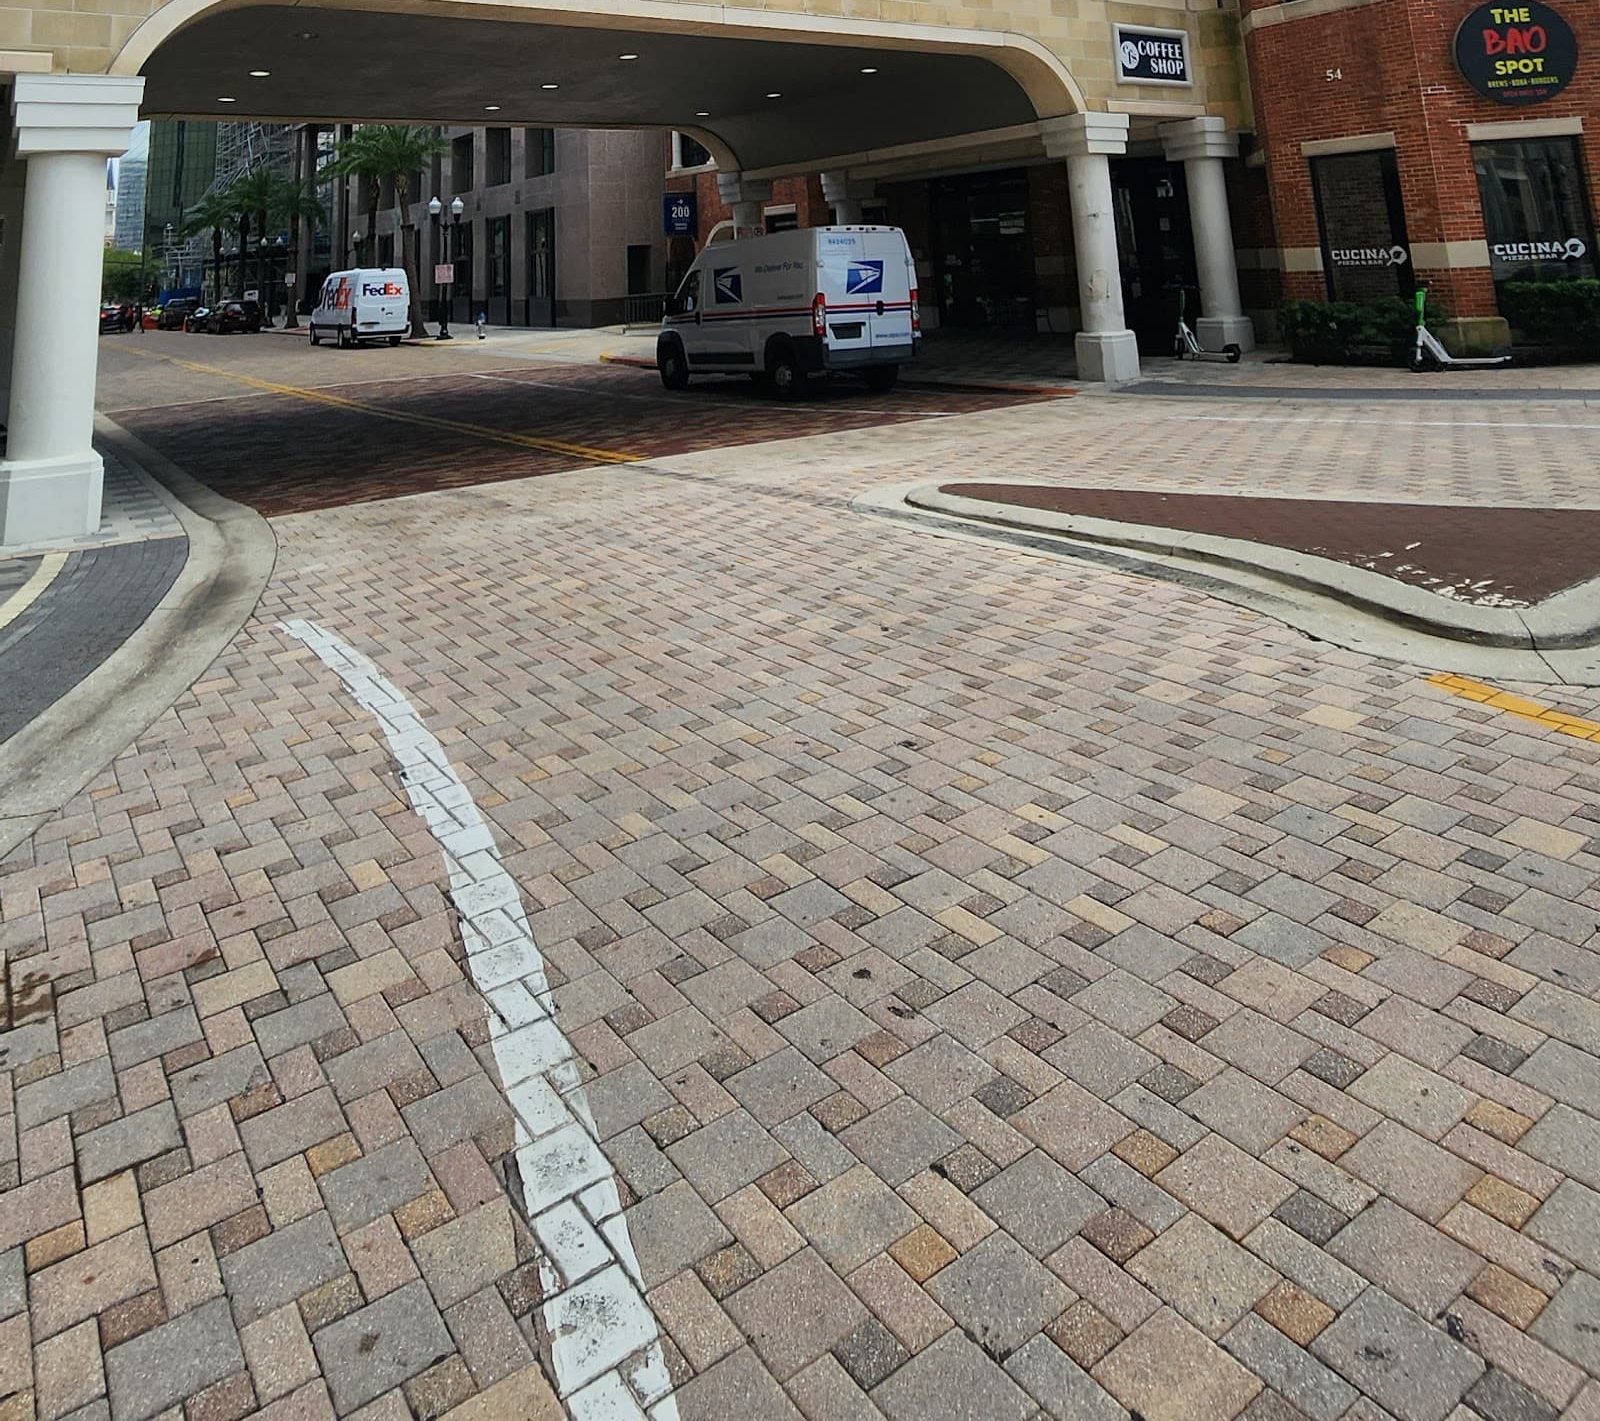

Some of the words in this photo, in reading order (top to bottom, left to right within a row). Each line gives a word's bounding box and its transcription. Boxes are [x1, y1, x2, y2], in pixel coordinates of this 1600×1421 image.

[1490, 7, 1531, 24] THE
[1482, 25, 1547, 55] BAO
[1137, 40, 1182, 59] COFFEE
[1150, 58, 1183, 75] SHOP
[1494, 58, 1544, 75] SPOT
[1326, 69, 1343, 81] 54
[671, 206, 690, 218] 200
[1331, 248, 1390, 260] CUCINA
[1494, 241, 1565, 255] CUCINA
[362, 282, 403, 296] FedEx
